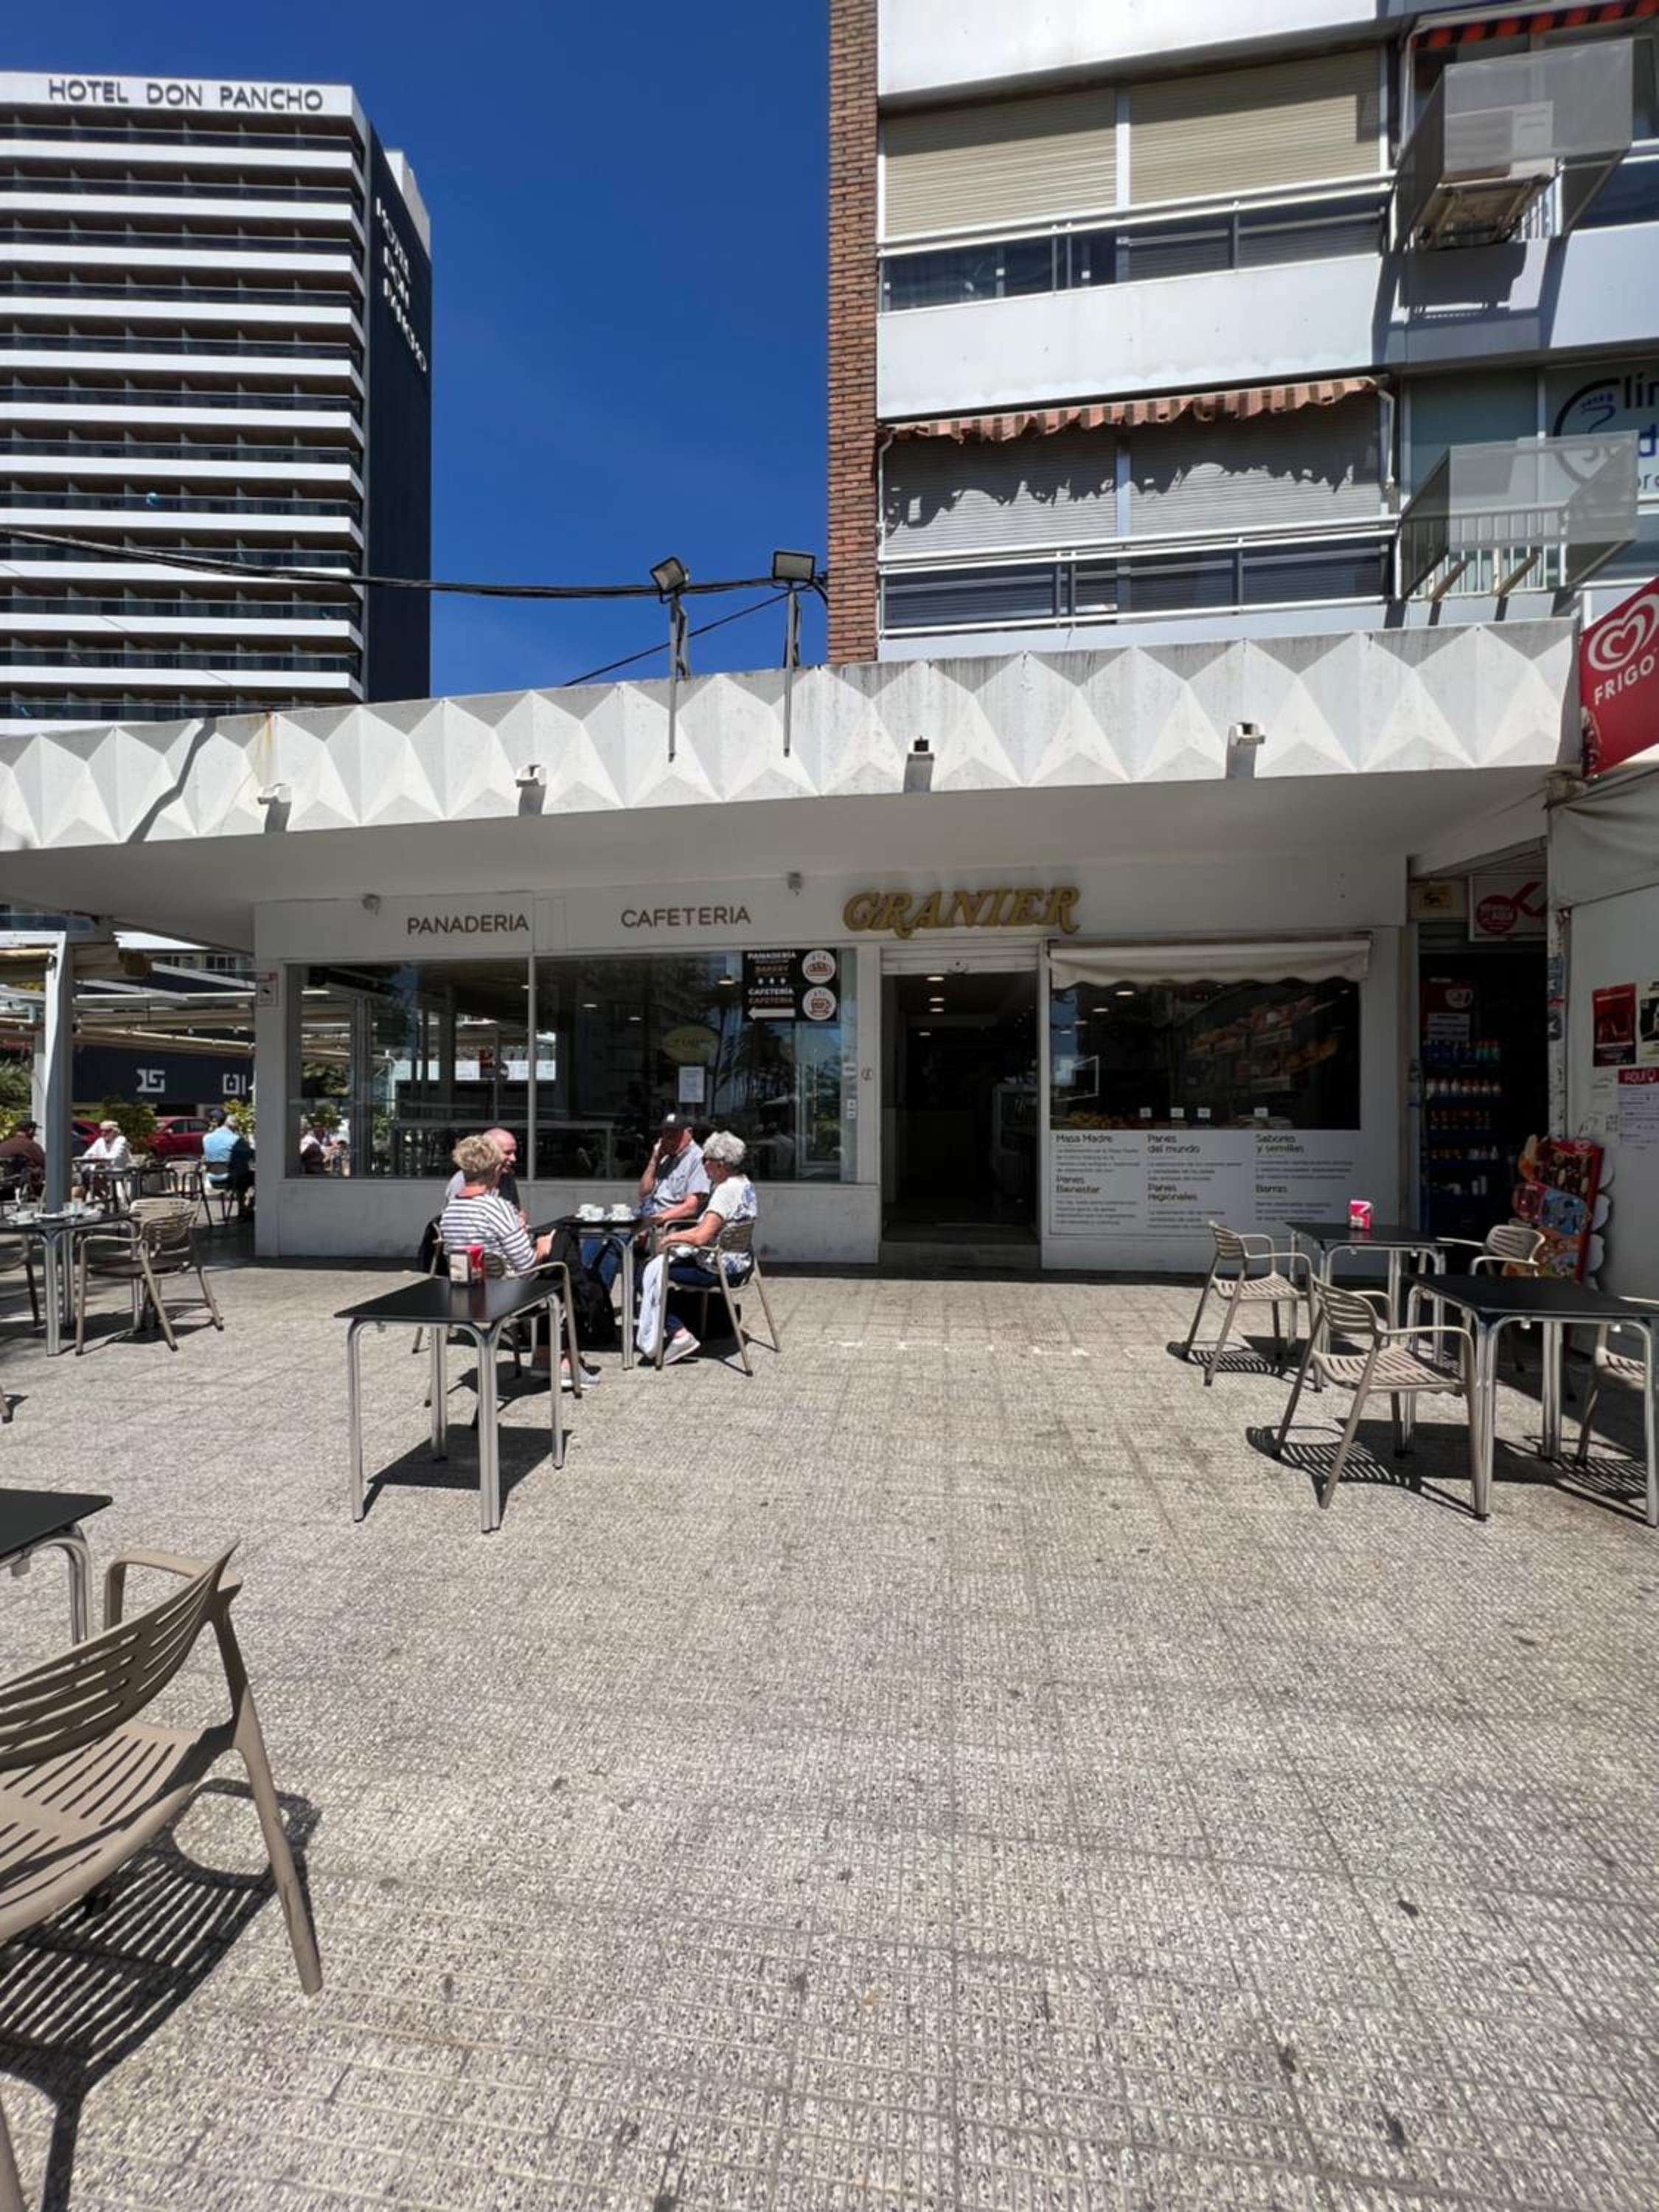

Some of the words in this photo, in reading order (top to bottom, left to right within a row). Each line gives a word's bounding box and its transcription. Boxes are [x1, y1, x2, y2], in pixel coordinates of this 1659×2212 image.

[49, 79, 129, 103] HOTEL
[147, 83, 203, 107] DON
[220, 86, 323, 111] PANCHO
[1593, 654, 1655, 706] FRIGO
[620, 905, 751, 929] CAFETERIA
[843, 885, 1080, 940] GRANIER
[407, 914, 530, 936] PANADERIA
[1056, 1134, 1080, 1143] Masa
[1082, 1134, 1113, 1143] Madre
[1148, 1134, 1178, 1143] Panes
[1256, 1133, 1297, 1143] Sabores
[1147, 1145, 1164, 1153] del
[1166, 1145, 1200, 1153] mundo
[1256, 1144, 1264, 1154] y
[1266, 1144, 1304, 1153] semillas
[1056, 1175, 1084, 1183] Panes
[1148, 1183, 1177, 1192] Panes
[1147, 1192, 1198, 1203] regionales
